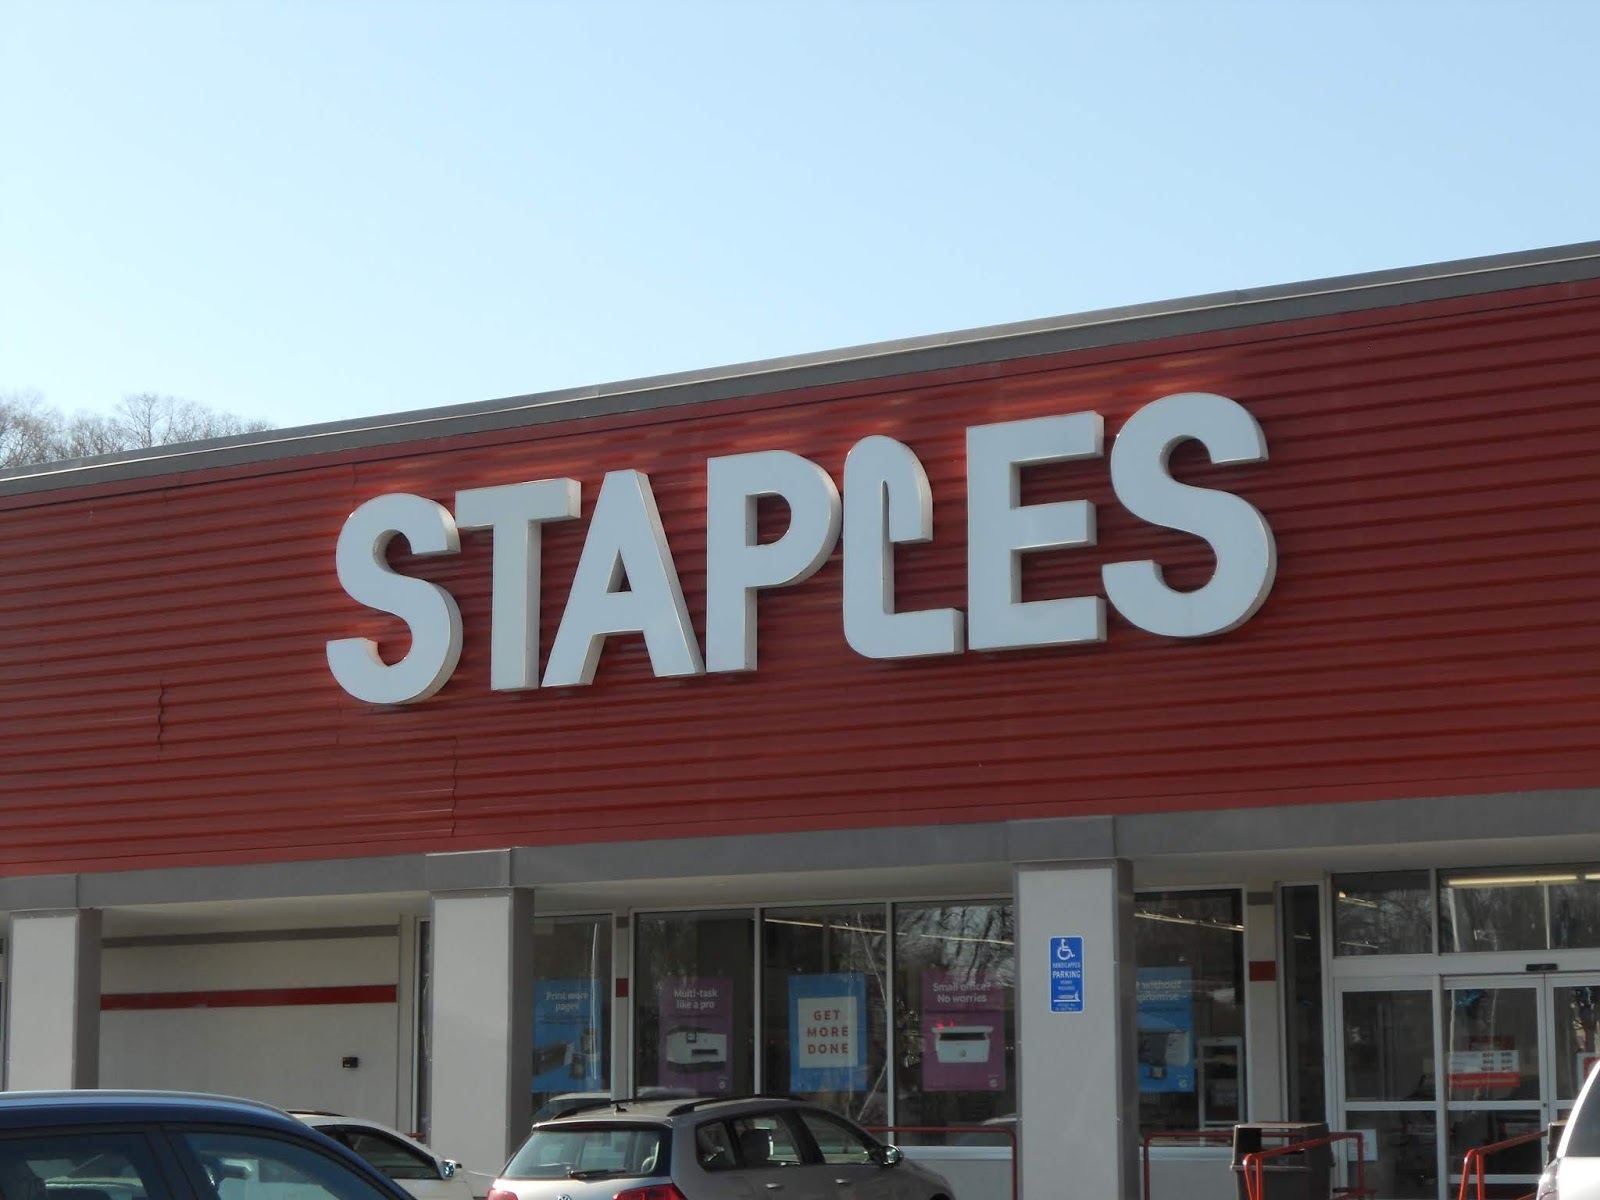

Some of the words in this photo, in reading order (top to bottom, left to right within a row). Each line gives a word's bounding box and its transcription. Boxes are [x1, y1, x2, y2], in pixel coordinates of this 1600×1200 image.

[326, 391, 1277, 705] STAPLES
[1052, 970, 1081, 979] PARKING
[932, 982, 958, 992] Small
[960, 981, 991, 991] office?
[546, 992, 567, 1000] Print
[568, 992, 589, 1000] more
[674, 988, 719, 998] Multi-task
[937, 993, 951, 1003] No
[952, 993, 988, 1003] worries
[676, 1000, 692, 1009] like
[693, 1001, 699, 1009] a
[700, 1001, 715, 1012] pro
[813, 1009, 840, 1021] GET
[806, 1026, 849, 1038] MORE
[808, 1043, 849, 1054] DONE
